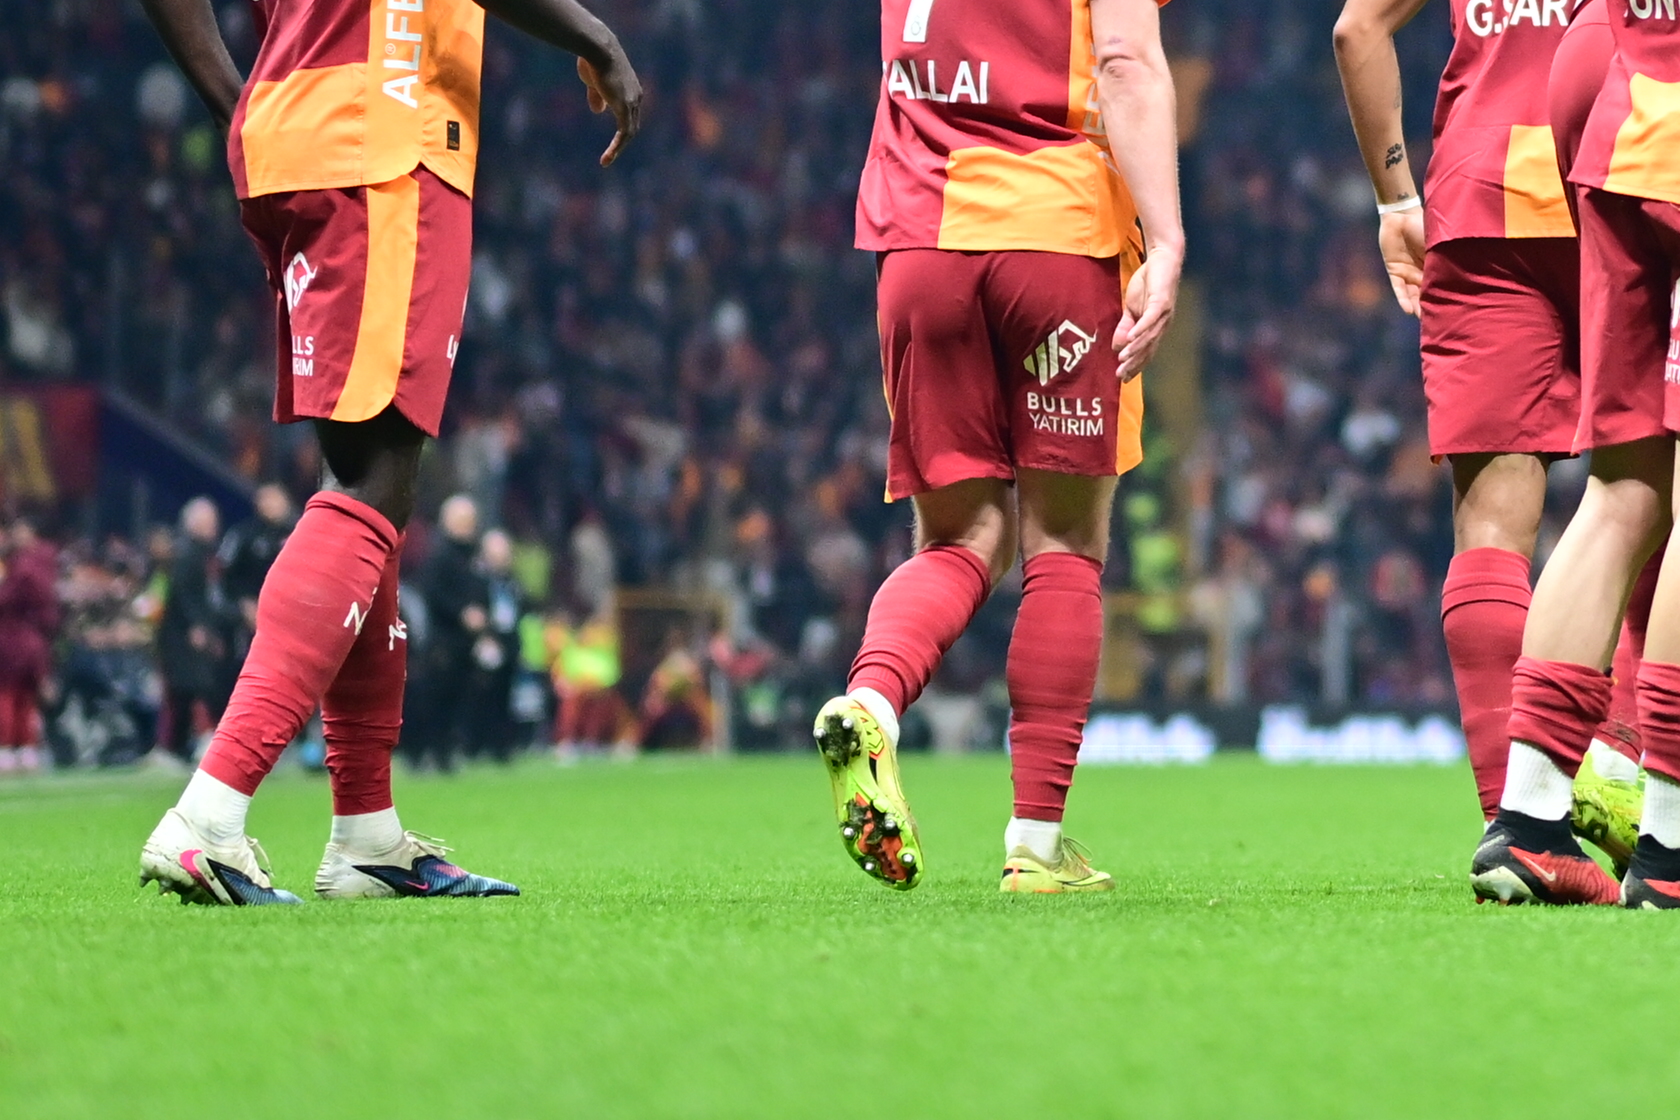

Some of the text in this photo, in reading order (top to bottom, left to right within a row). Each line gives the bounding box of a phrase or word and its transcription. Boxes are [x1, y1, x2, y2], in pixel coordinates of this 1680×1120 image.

[882, 59, 989, 105] ALLAI
[1027, 391, 1102, 417] BULLS
[1028, 411, 1104, 437] YATIRIM
